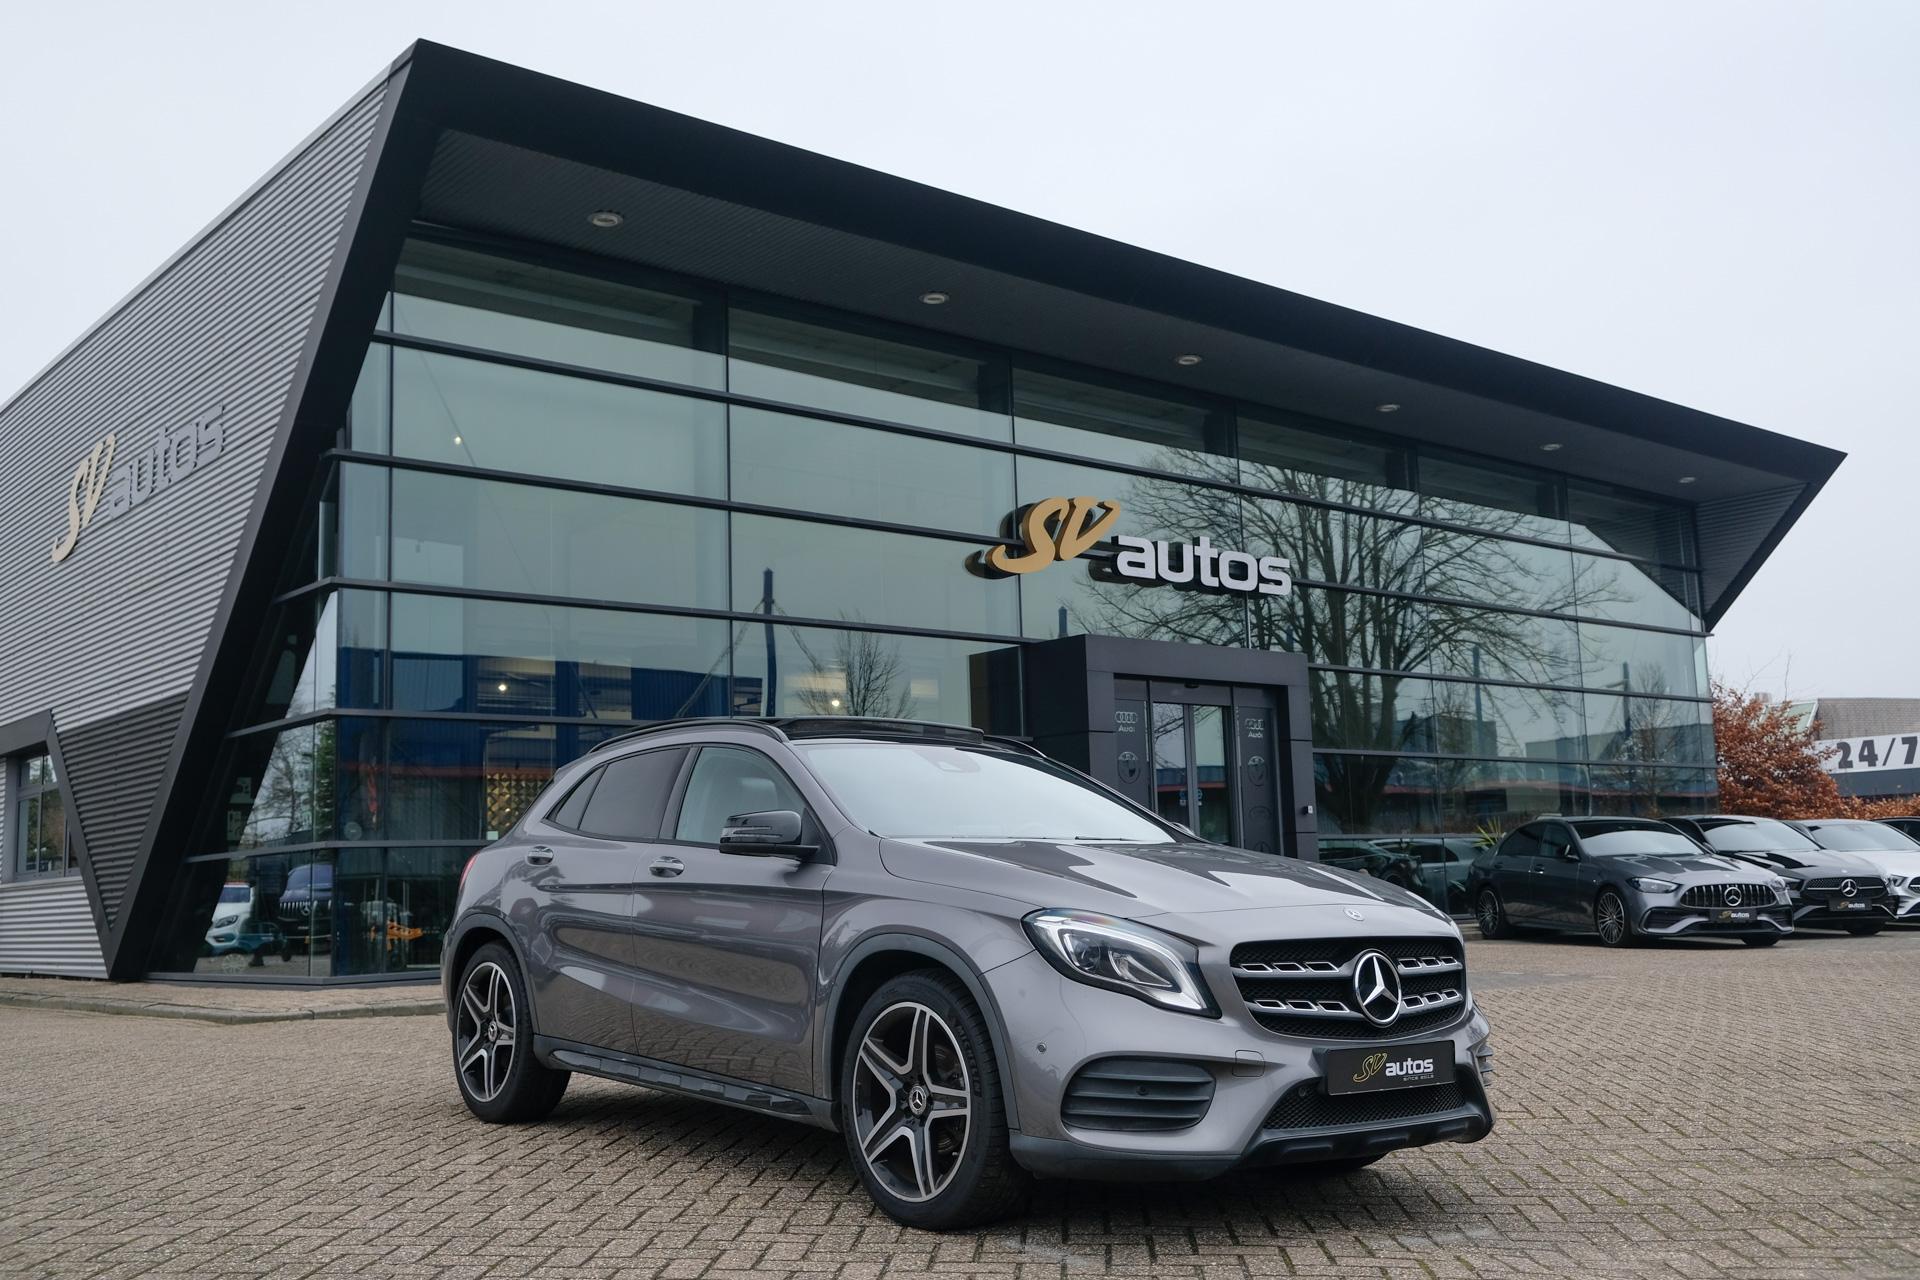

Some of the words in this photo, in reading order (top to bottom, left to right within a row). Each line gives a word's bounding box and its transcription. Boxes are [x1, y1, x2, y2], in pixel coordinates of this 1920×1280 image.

[108, 402, 224, 518] autos
[1115, 535, 1292, 595] autos
[1836, 736, 1918, 769] 24/7
[1385, 1058, 1433, 1076] autos
